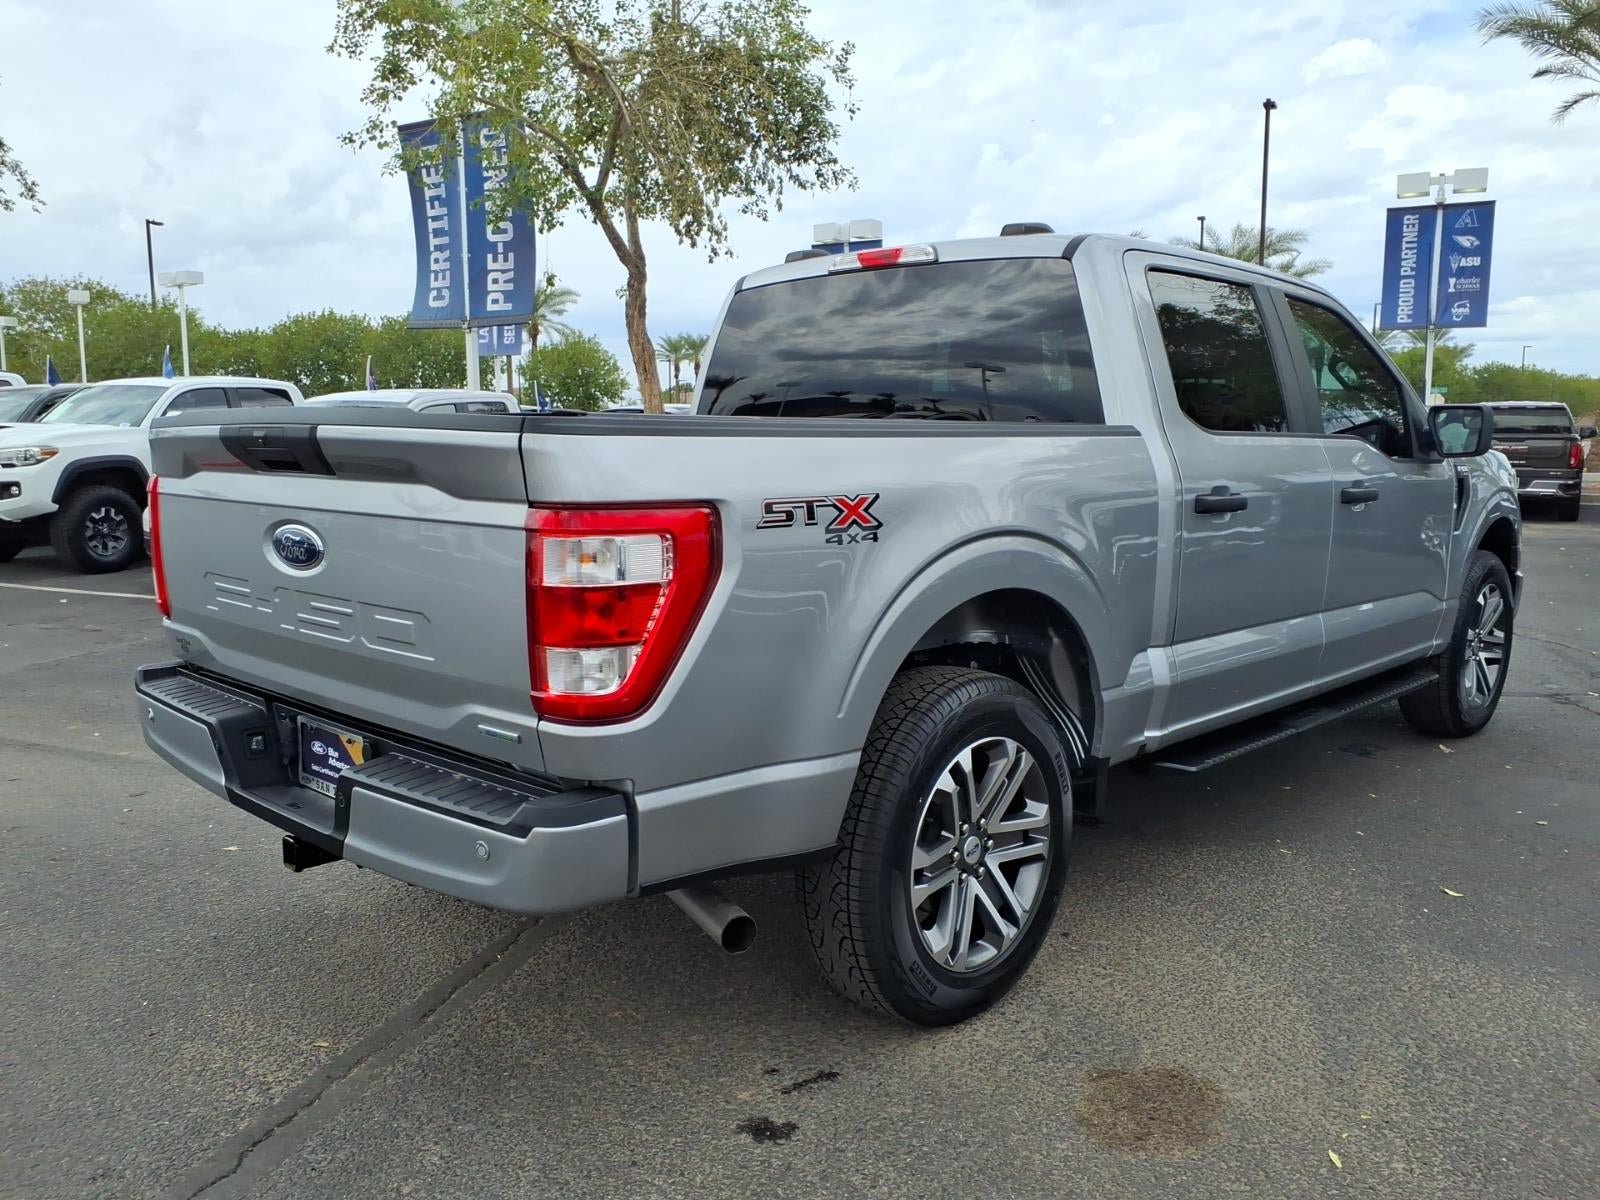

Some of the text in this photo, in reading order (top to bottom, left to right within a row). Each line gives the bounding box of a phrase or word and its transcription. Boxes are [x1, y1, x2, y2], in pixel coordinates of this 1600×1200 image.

[419, 144, 450, 308] CERTIFIE
[1397, 214, 1420, 323] PROUD PARTNER
[1459, 256, 1481, 267] ASU
[756, 493, 883, 534] STX
[280, 533, 308, 561] Ford
